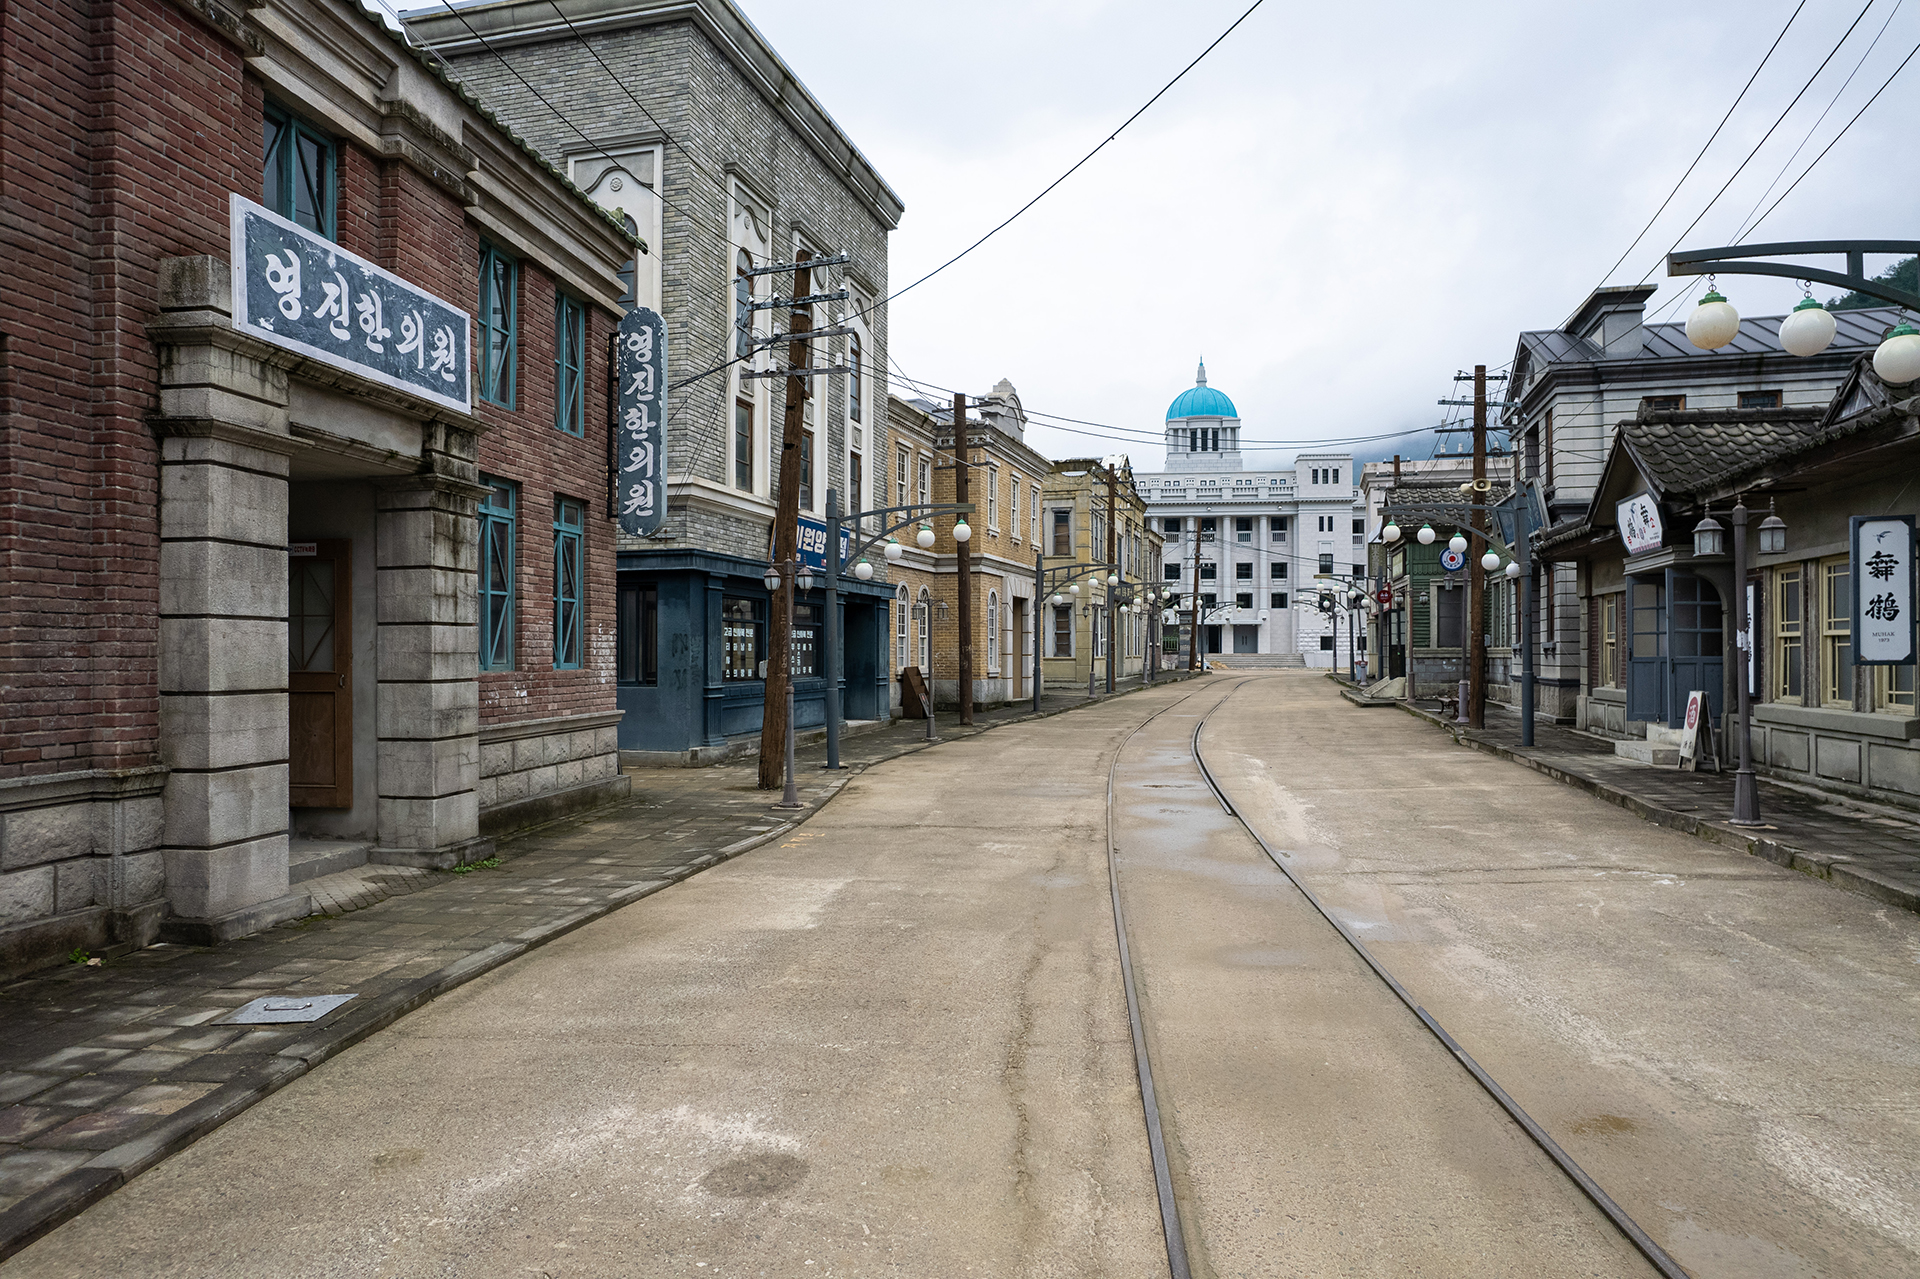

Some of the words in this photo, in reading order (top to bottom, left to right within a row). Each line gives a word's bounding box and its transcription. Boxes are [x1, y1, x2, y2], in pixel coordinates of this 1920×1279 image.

[265, 248, 456, 382] 영진한의원
[623, 326, 657, 517] 영진한의원
[1865, 550, 1901, 622] 舞鶴
